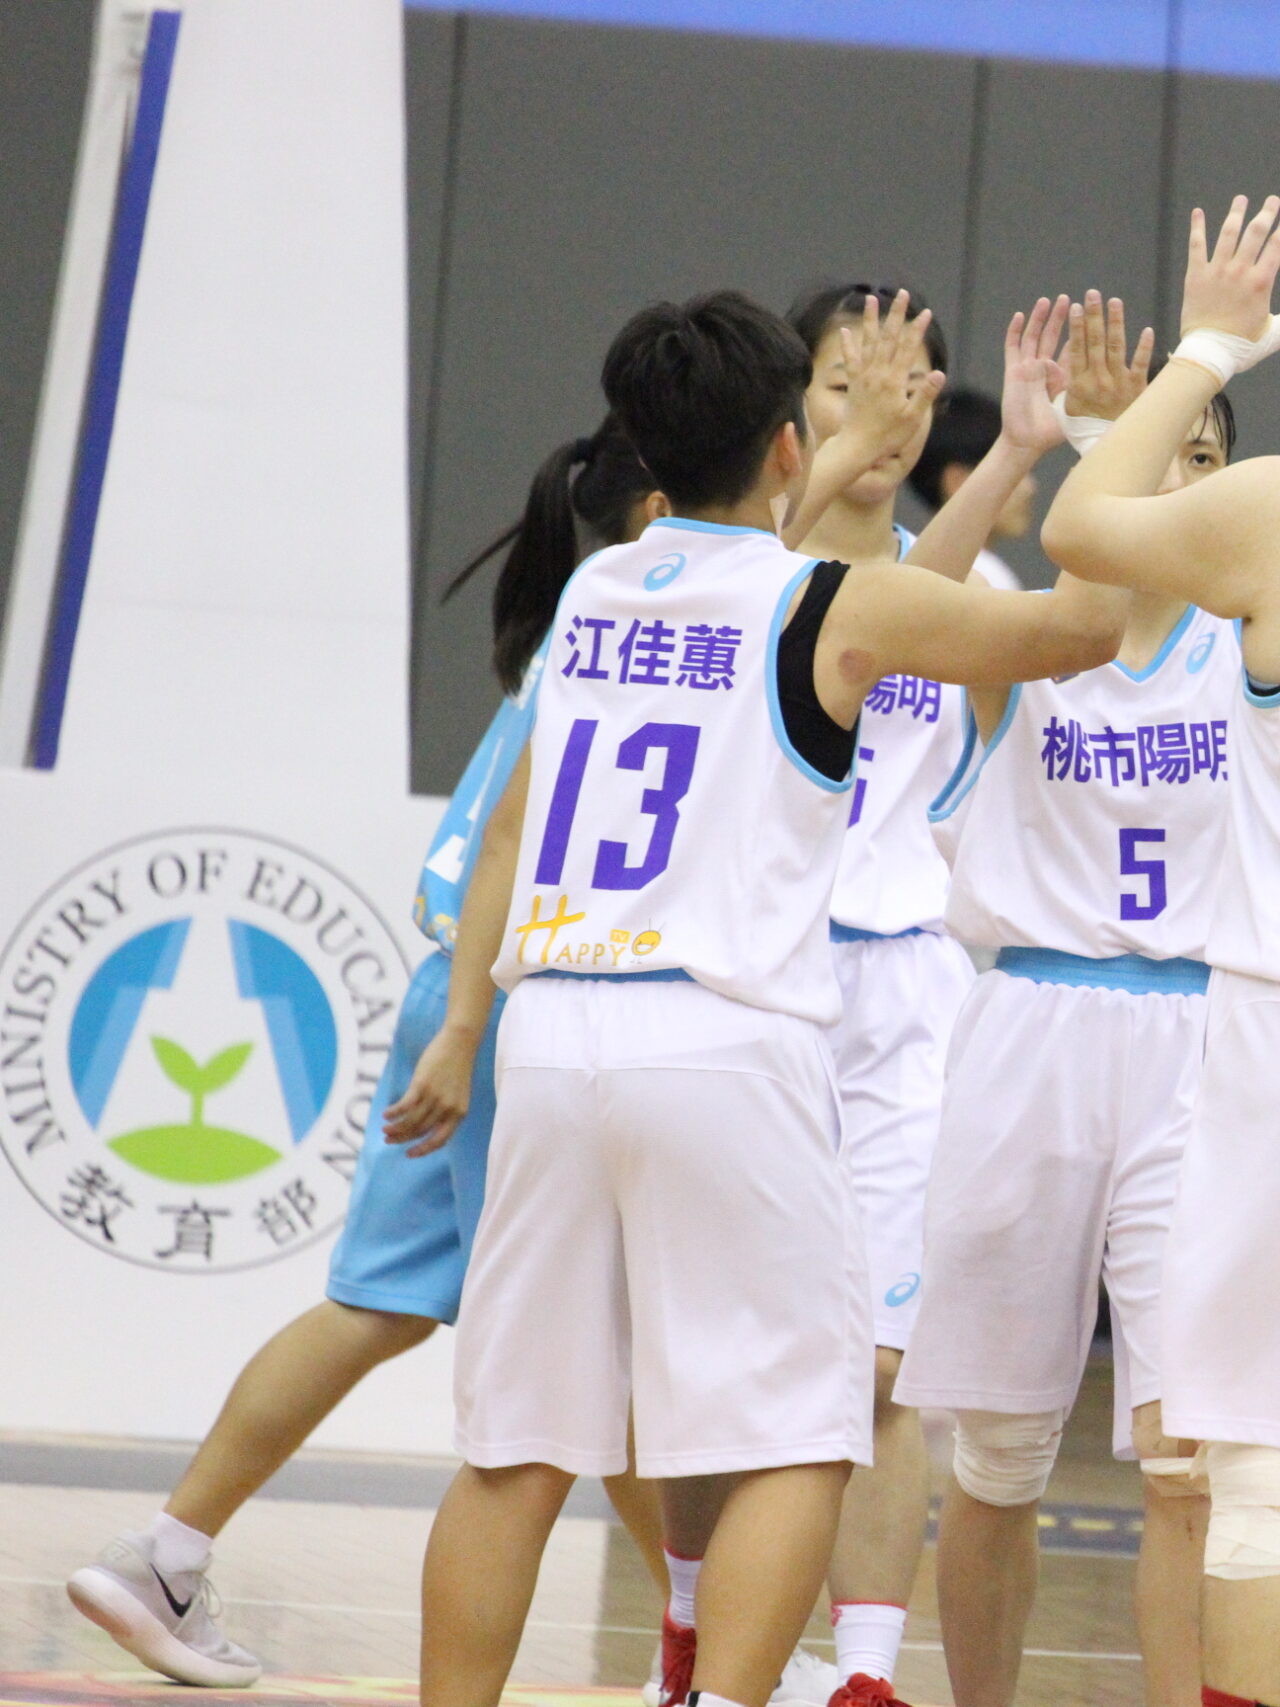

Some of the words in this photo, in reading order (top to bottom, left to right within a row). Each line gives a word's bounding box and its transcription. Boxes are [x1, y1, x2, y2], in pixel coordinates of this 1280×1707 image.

[1041, 716, 1228, 787] 桃市陽明
[534, 718, 702, 891] 13
[1119, 828, 1167, 921] 5
[515, 894, 626, 967] HAPPY
[1, 868, 128, 1156] MINISTRY
[147, 848, 228, 898] OF
[246, 858, 396, 1183] EDUCATION
[60, 1162, 318, 1263] 教育部
